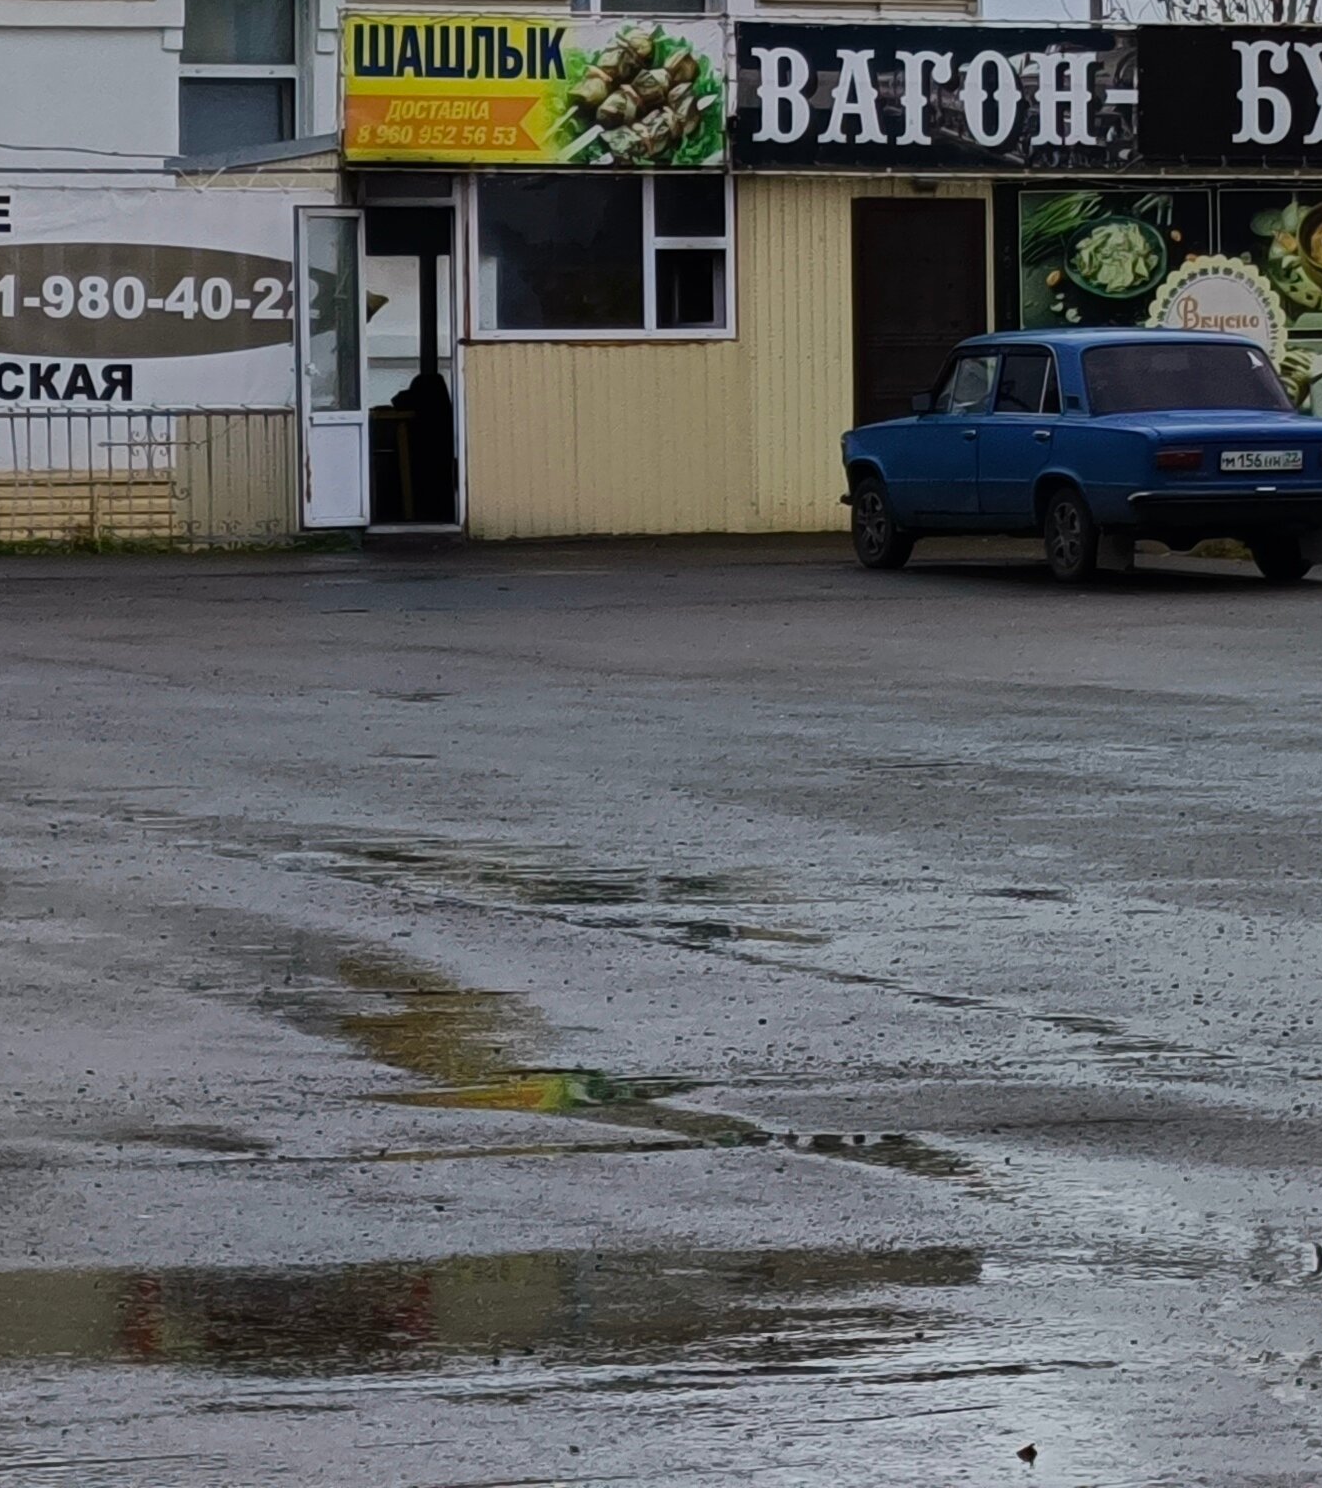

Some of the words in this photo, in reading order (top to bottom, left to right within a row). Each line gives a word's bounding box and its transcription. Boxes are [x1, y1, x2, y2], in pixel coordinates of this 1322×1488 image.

[354, 23, 566, 80] ШАШЛЫК
[385, 99, 490, 123] ДОСТАВКА
[357, 126, 369, 143] 8
[376, 126, 412, 144] 960
[418, 126, 455, 144] 952
[493, 126, 518, 144] 53
